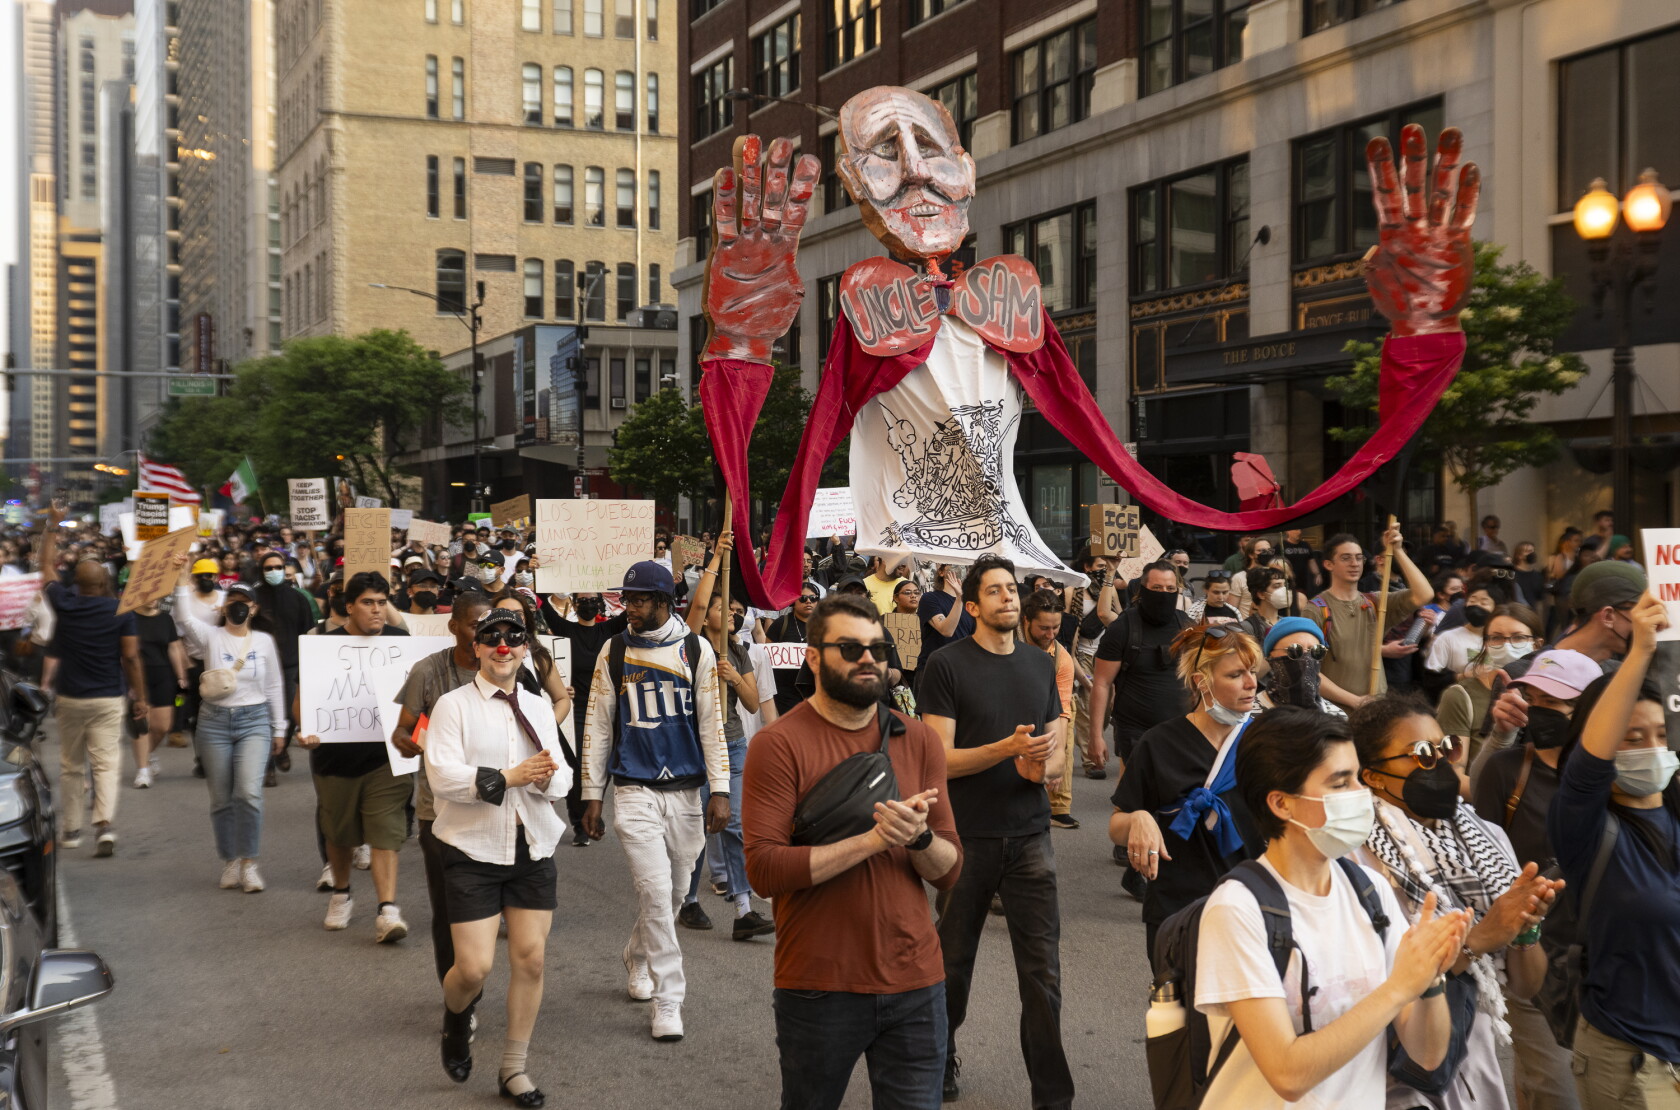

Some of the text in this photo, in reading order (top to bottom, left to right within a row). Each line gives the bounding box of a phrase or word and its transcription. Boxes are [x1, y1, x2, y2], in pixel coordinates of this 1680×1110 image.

[840, 261, 1041, 347] UNCLE SAM
[1223, 342, 1296, 365] THE BOYCE
[137, 502, 165, 511] Trump
[539, 500, 654, 522] LOS PUEBLOS
[135, 516, 167, 525] Regime
[345, 512, 388, 529] ICE
[1104, 510, 1139, 531] ICE
[355, 530, 376, 546] IS
[541, 525, 653, 543] UNIDOS JAMAS
[1106, 532, 1138, 551] OUT
[347, 547, 389, 564] EVIL
[539, 546, 586, 565] SERAN
[569, 563, 604, 578] LUCHA
[338, 644, 401, 671] STOP
[327, 671, 375, 701] MA
[626, 680, 694, 729] Lite
